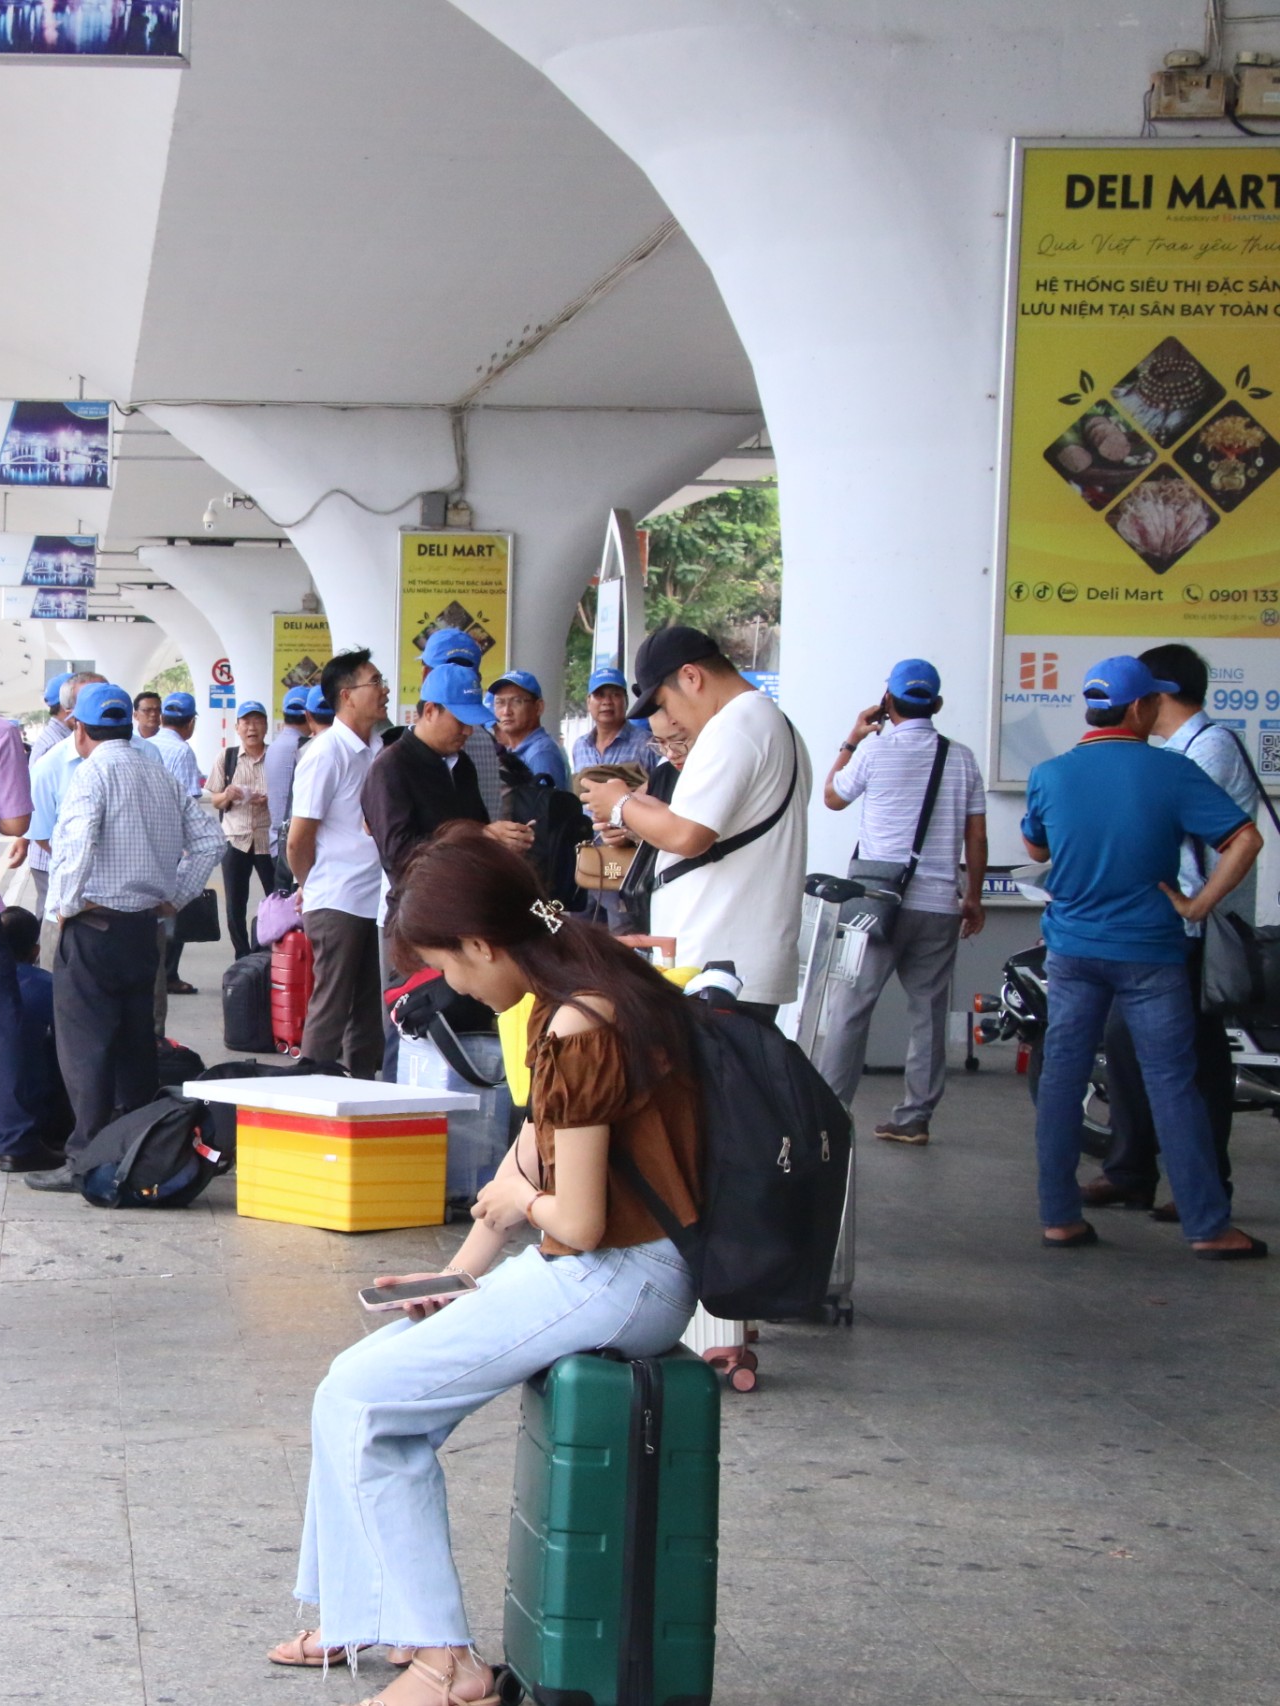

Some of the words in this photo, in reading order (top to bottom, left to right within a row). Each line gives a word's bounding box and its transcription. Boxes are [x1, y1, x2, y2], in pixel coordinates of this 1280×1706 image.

[1065, 173, 1154, 210] DELI
[1166, 174, 1280, 210] MART
[1036, 276, 1059, 295] HỆ
[1064, 275, 1125, 293] THỐNG
[1130, 277, 1168, 293] SIÊU
[1174, 279, 1202, 296] THỊ
[1206, 277, 1244, 296] ĐẶC
[1021, 301, 1055, 316] LƯU
[1060, 301, 1104, 319] NIỆM
[1109, 304, 1135, 319] TẠI
[1140, 301, 1175, 316] SÂN
[1181, 304, 1216, 316] BAY
[1221, 302, 1269, 317] TOÀN
[417, 544, 448, 556] DELI
[452, 544, 495, 557] MART
[1087, 587, 1120, 601] Deli
[1125, 588, 1164, 601] Mart
[1209, 589, 1248, 602] 0901
[1253, 590, 1279, 602] 133
[283, 621, 303, 630] DELI
[1213, 688, 1259, 711] 999
